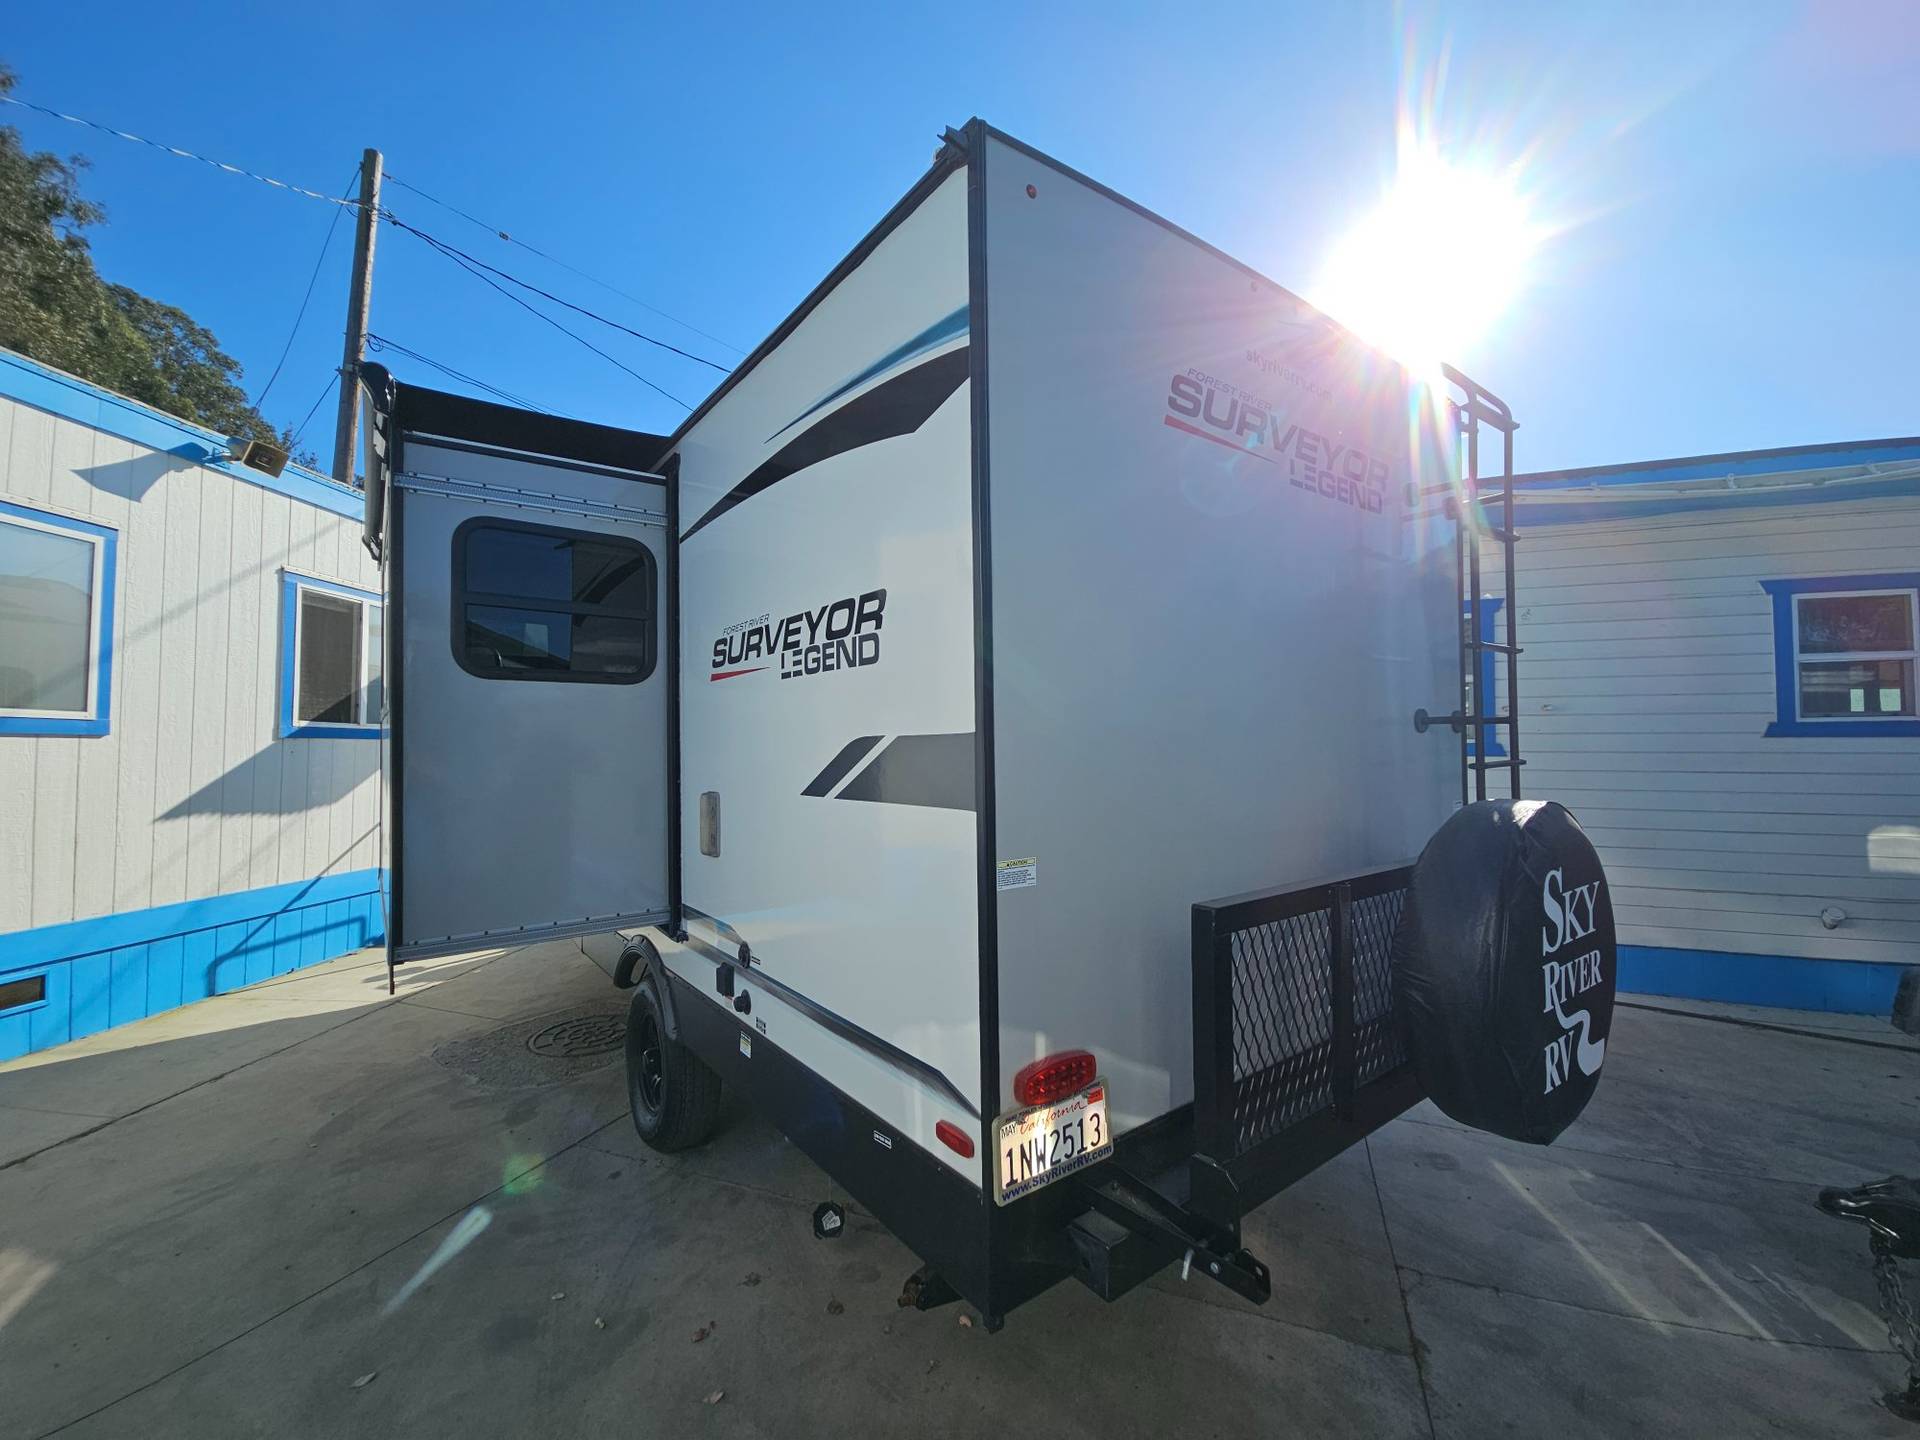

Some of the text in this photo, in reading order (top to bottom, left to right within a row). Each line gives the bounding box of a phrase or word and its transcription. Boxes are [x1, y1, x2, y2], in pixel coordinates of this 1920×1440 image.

[1187, 368, 1237, 394] FOREST
[1168, 374, 1389, 491] SURVEYOR
[1290, 459, 1383, 514] LEGEND
[712, 588, 887, 669] SURVEYOR
[723, 613, 770, 636] FOREST RIVER
[781, 632, 880, 680] LEGEND
[1542, 949, 1602, 1013] RIVER
[1544, 1030, 1574, 1095] RV
[1001, 1122, 1017, 1139] MAY
[1005, 1112, 1101, 1189] 1NW2513
[1002, 1145, 1112, 1201] www.SkyRiverRV.com
